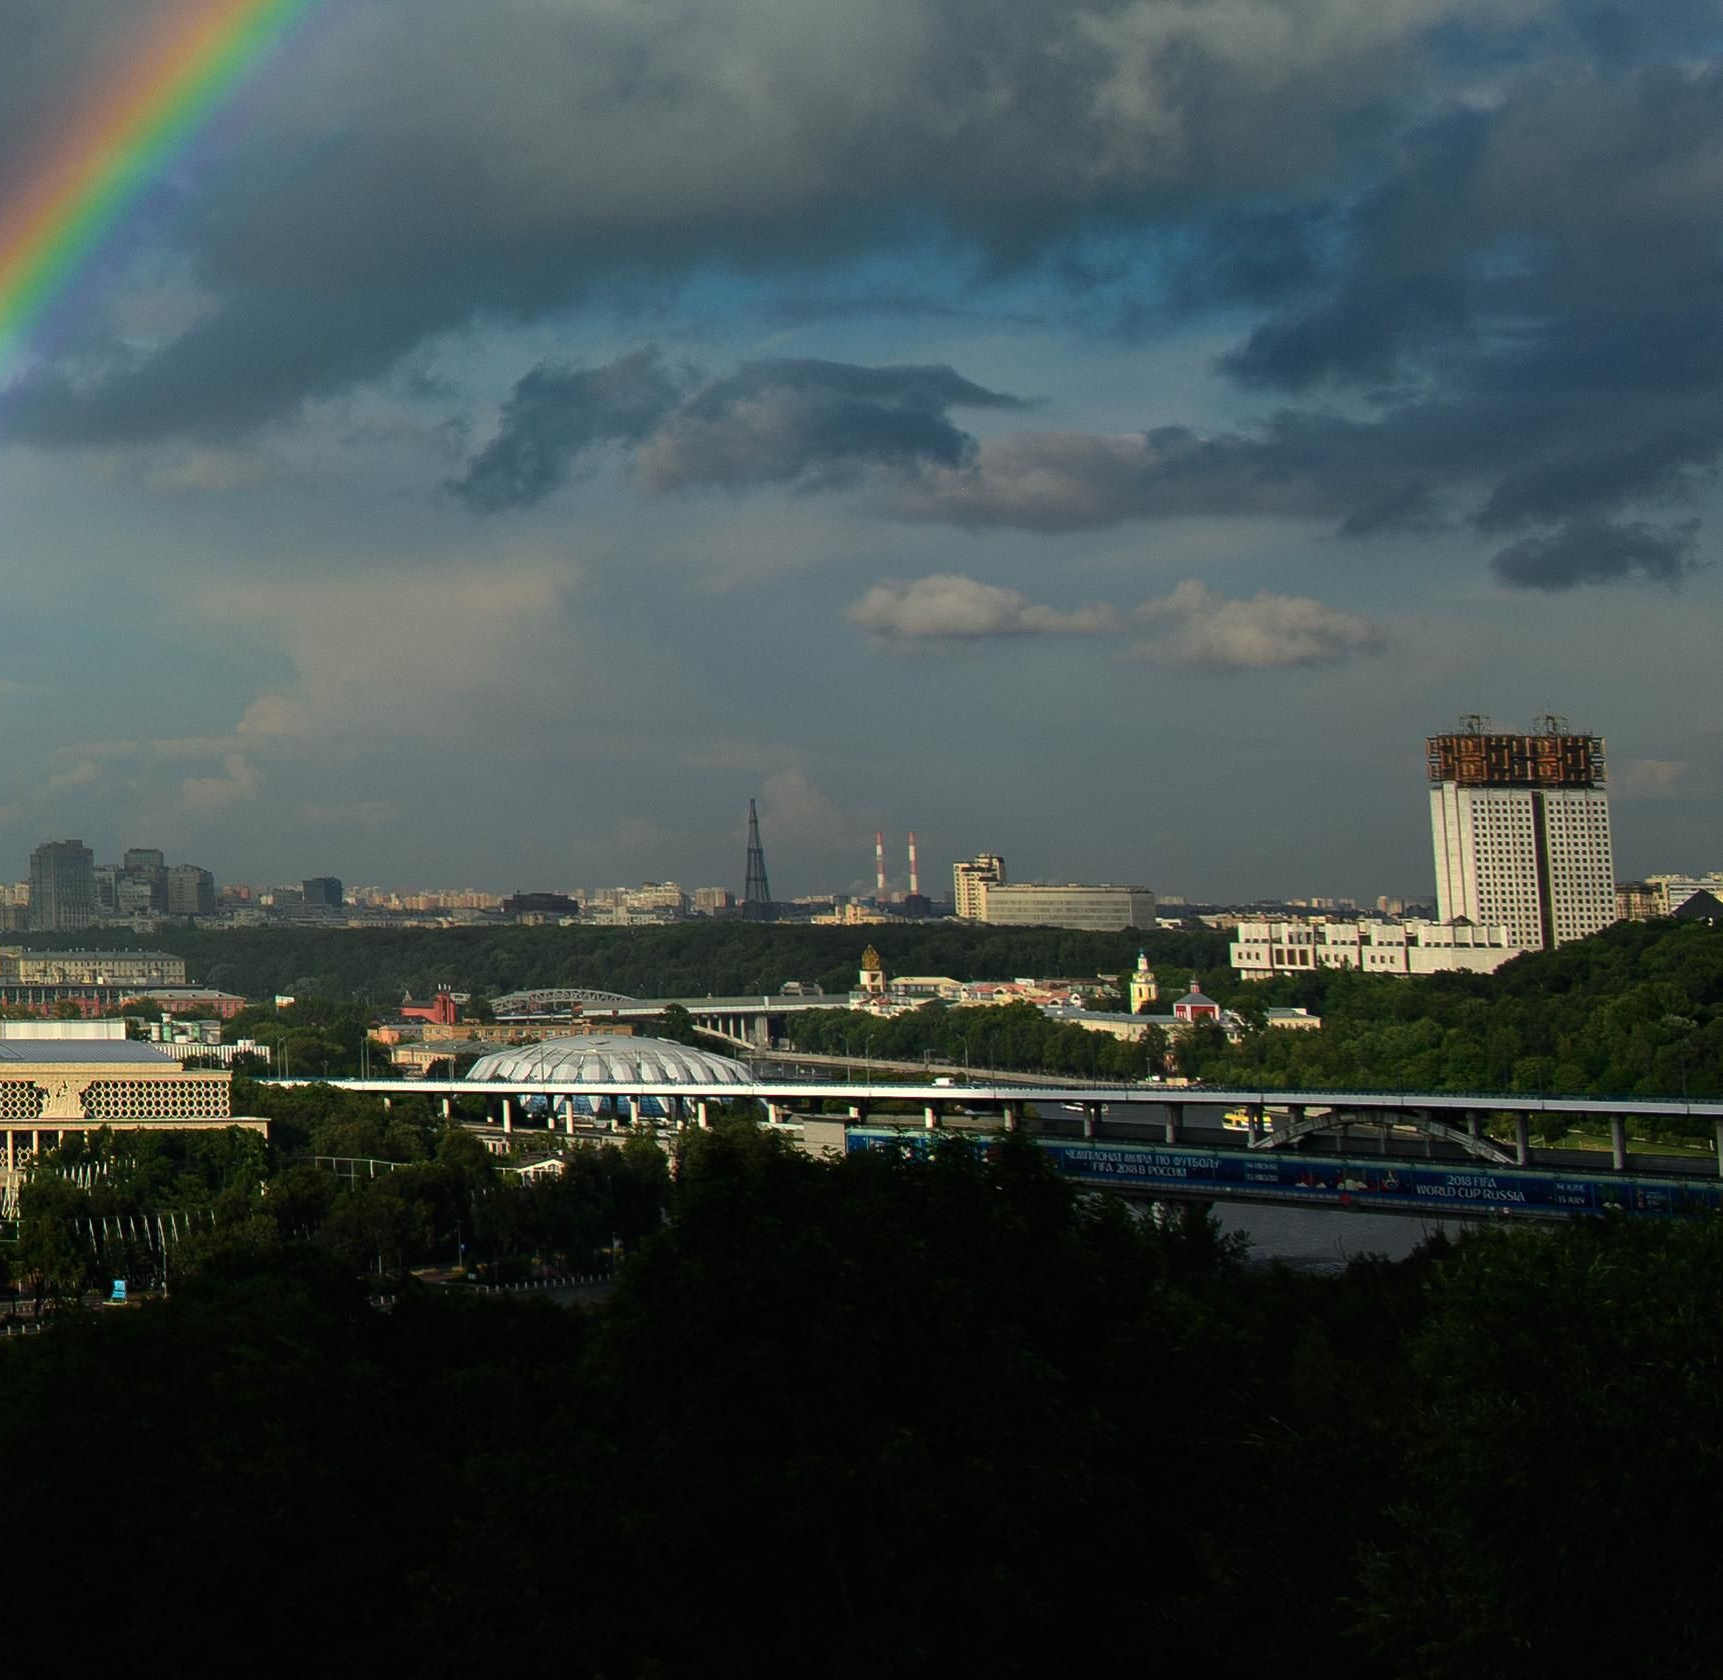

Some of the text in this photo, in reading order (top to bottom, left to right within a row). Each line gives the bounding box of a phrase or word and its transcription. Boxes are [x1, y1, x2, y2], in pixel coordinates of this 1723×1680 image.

[1155, 1154, 1171, 1166] ПО
[1447, 1175, 1497, 1188] 2018 FIFA
[1416, 1184, 1526, 1202] WORLD CUP RUSSIA
